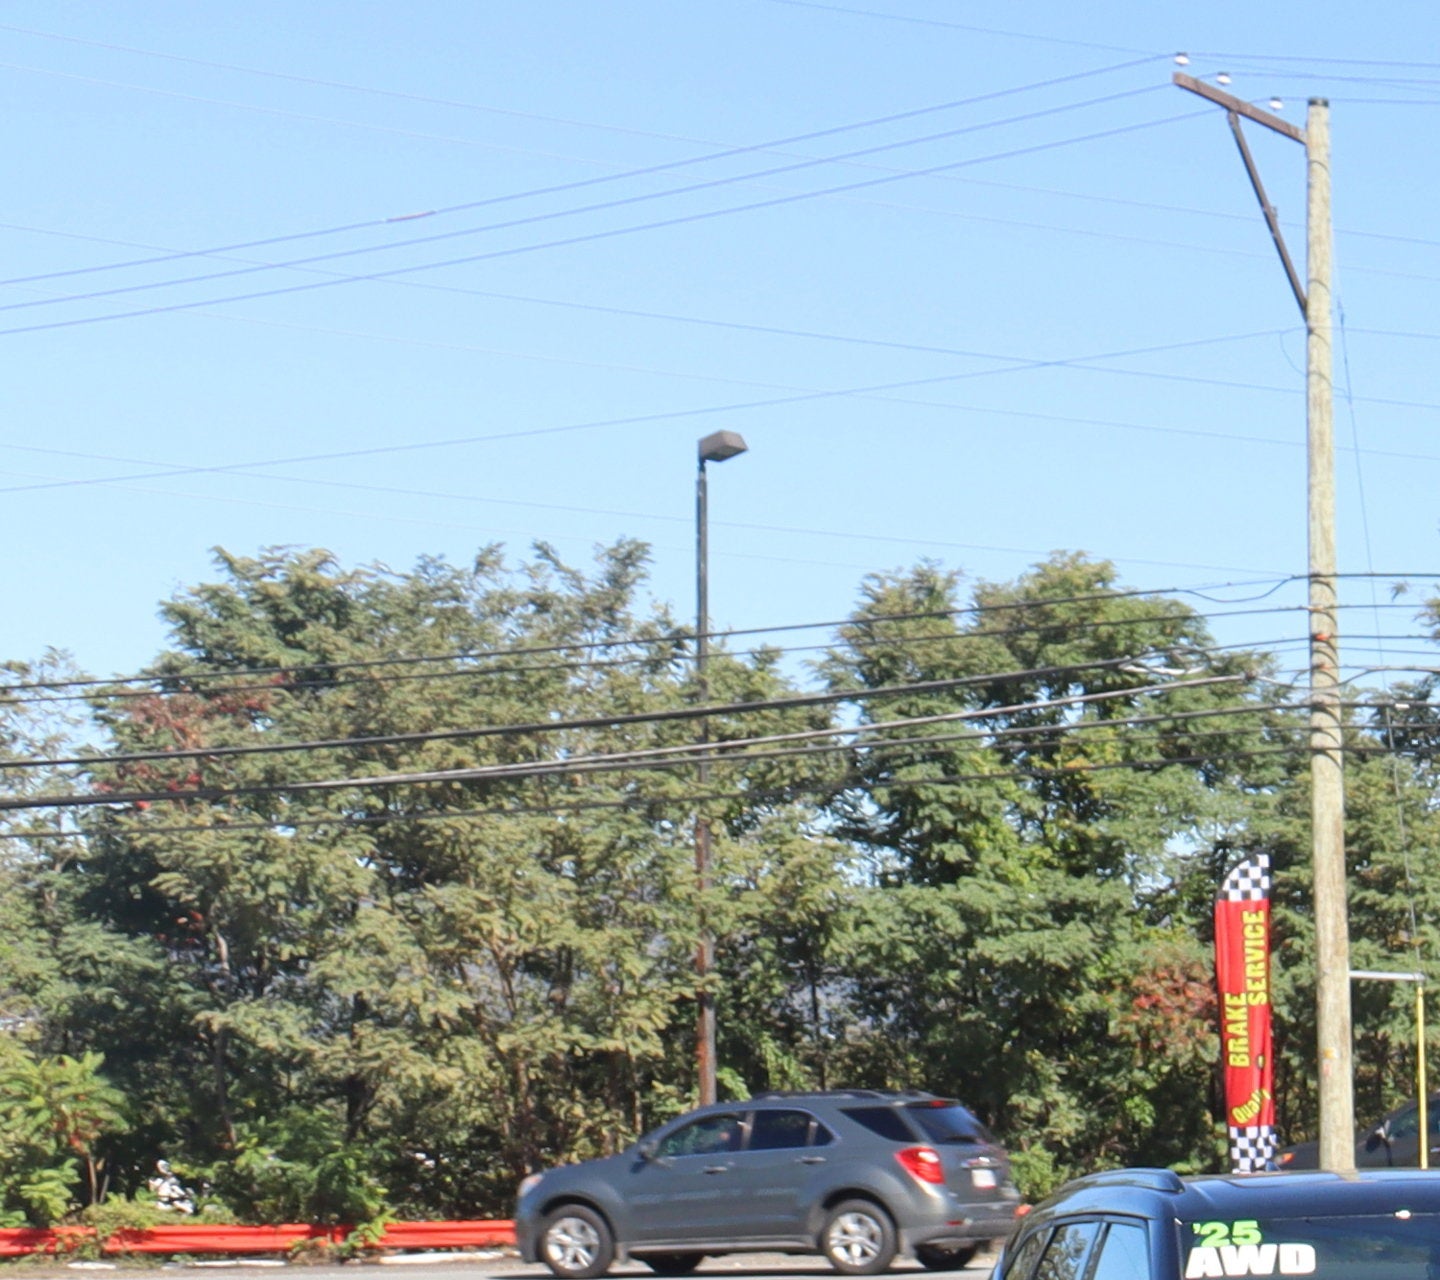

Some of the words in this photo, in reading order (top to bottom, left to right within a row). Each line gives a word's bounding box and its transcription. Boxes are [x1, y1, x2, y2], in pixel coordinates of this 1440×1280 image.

[1242, 909, 1268, 1007] SERVICE
[1225, 992, 1251, 1068] BRAKE
[1185, 1243, 1317, 1280] AWD
[1192, 1219, 1263, 1248] '25
